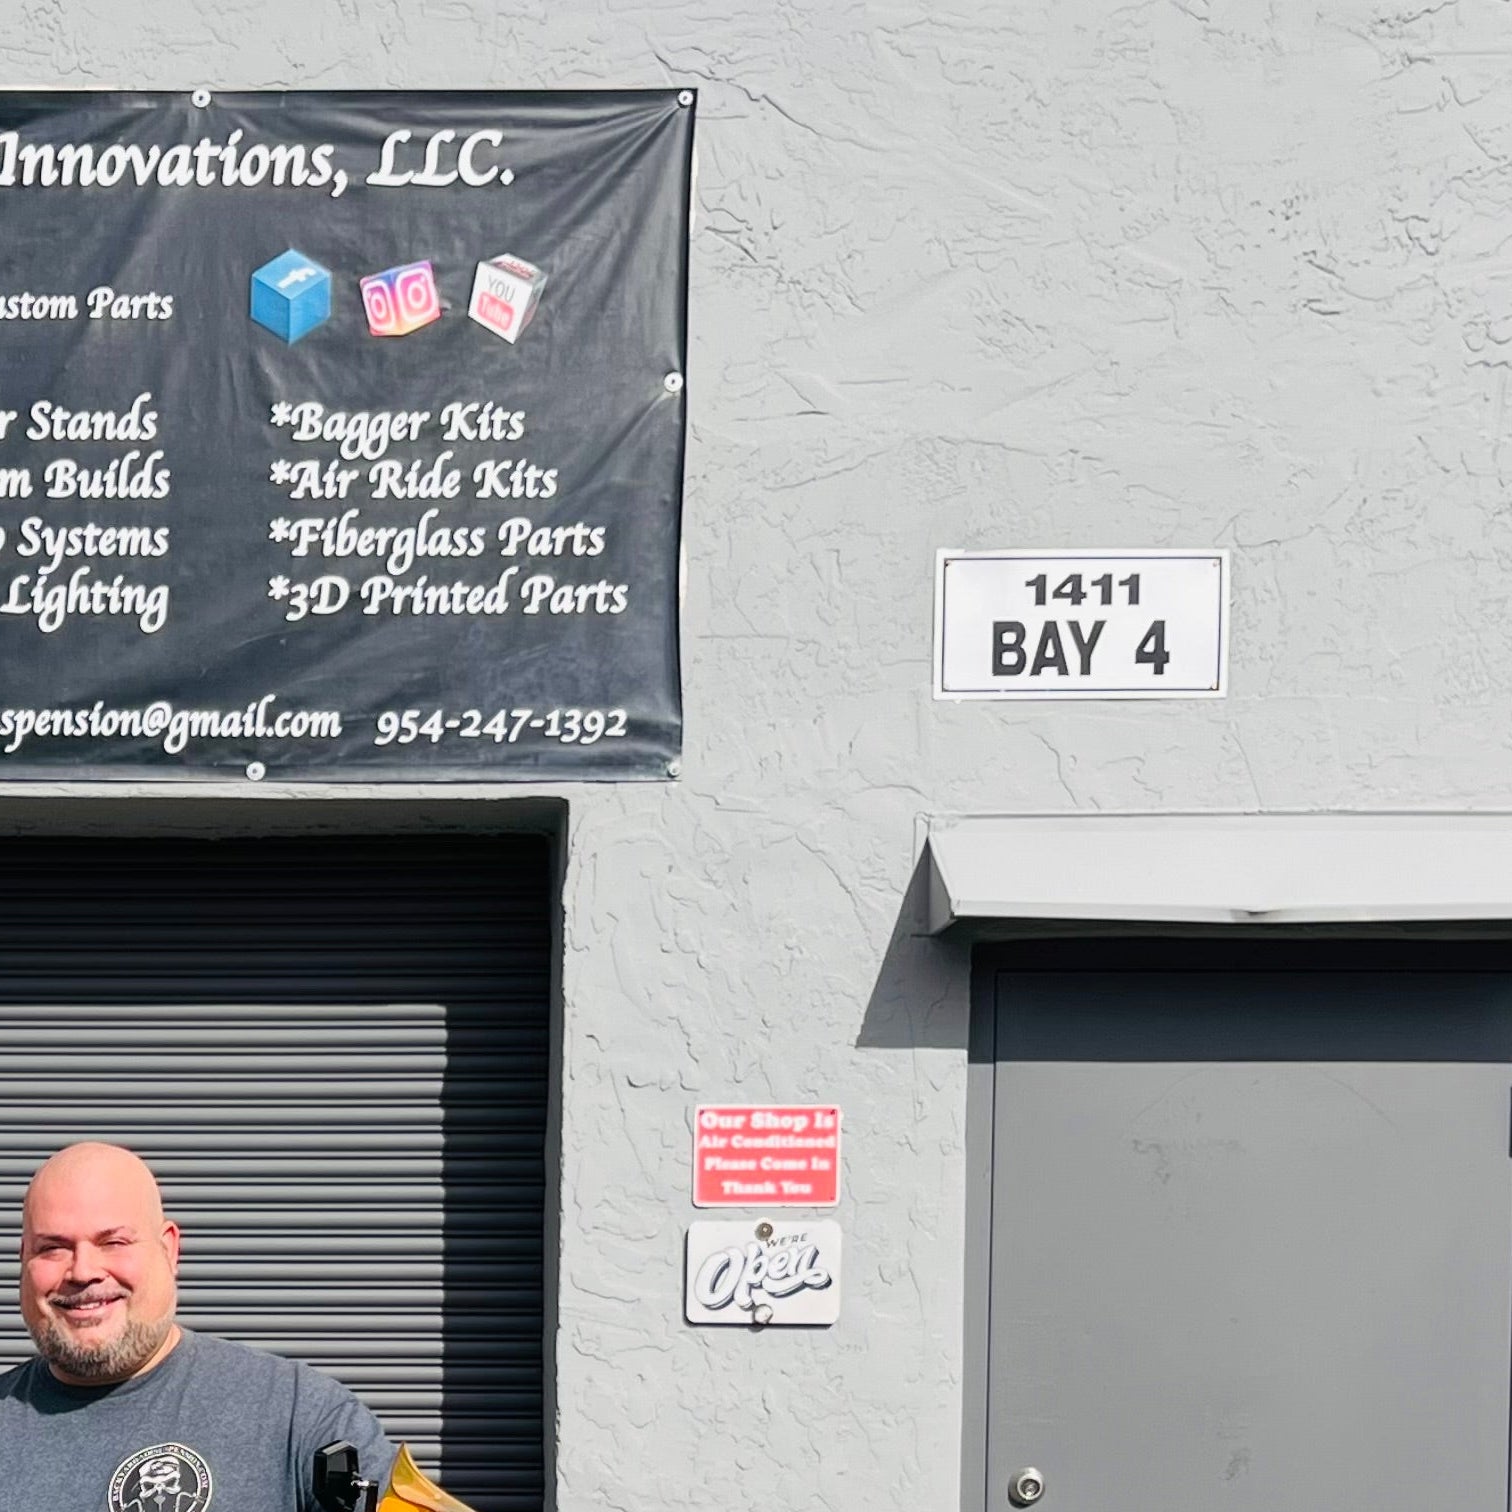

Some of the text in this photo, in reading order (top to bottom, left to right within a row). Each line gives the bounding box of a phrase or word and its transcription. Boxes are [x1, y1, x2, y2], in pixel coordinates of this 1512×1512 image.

[366, 130, 515, 187] LLC.
[86, 286, 174, 320] Parts
[489, 274, 515, 303] YOU
[26, 391, 158, 441] Stands
[439, 400, 526, 441] Kits
[44, 449, 171, 499] Builds
[368, 450, 462, 499] Ride
[472, 457, 559, 499] Kits
[16, 516, 170, 572] Systems
[497, 516, 606, 557] Parts
[0, 567, 170, 632] Lighting
[360, 568, 514, 615] Printed
[520, 573, 629, 614] Parts
[1025, 573, 1141, 606] 1411
[992, 620, 1170, 676] BAY 4
[374, 708, 628, 744] 954-247-1392
[701, 1112, 834, 1131] Our Shop Is
[699, 1136, 727, 1149] Air
[704, 1157, 830, 1171] Please Come In
[721, 1181, 813, 1195] Thank You
[694, 1241, 832, 1311] Open
